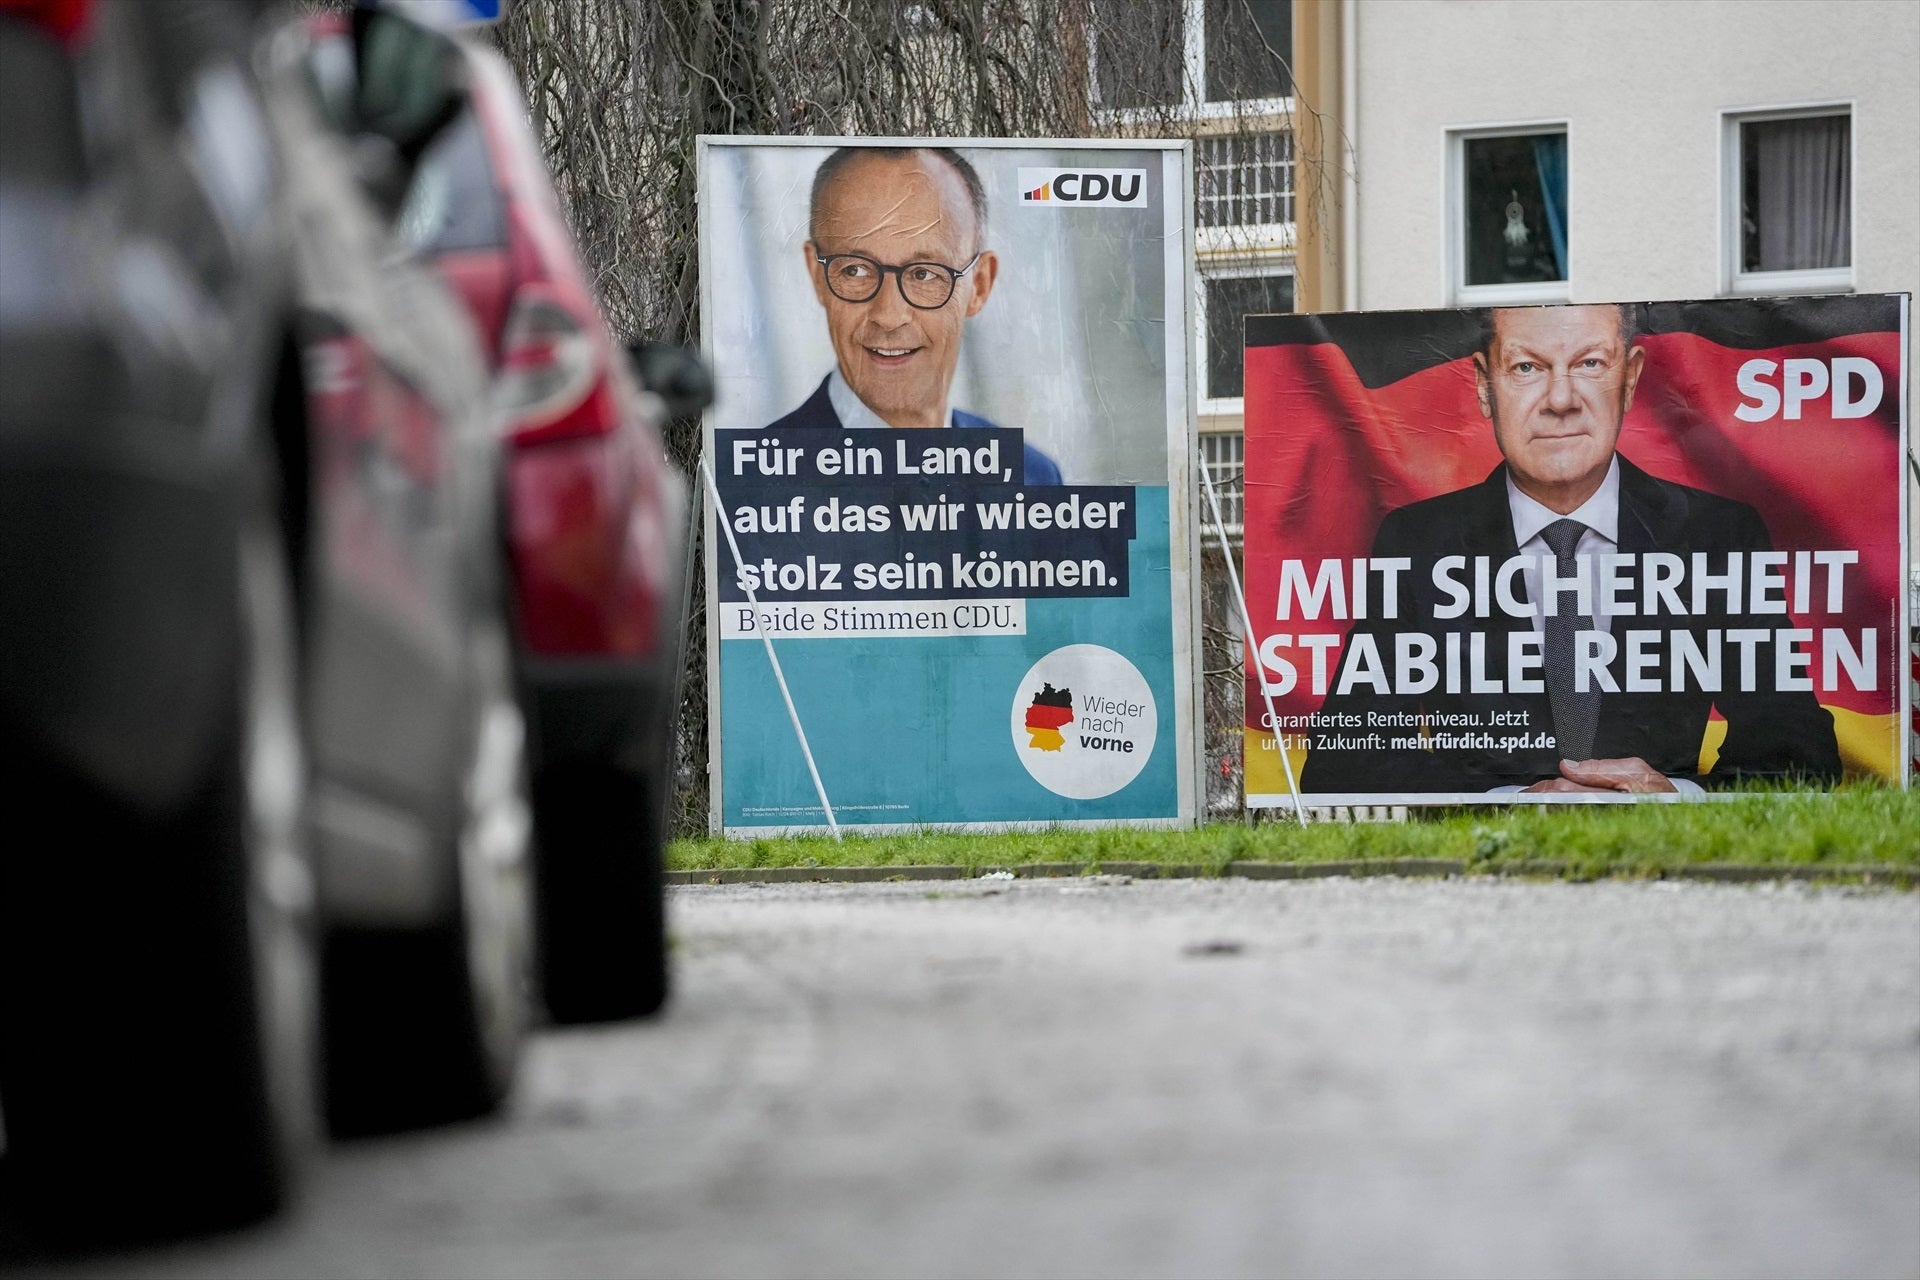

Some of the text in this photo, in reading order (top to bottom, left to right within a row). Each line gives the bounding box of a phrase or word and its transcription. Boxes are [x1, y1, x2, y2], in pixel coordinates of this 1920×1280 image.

[1052, 173, 1142, 202] CDU
[1733, 357, 1884, 423] SPD
[733, 437, 1012, 482] Für ein Land,
[734, 492, 1126, 534] auf das wir wieder
[736, 550, 1119, 592] stolz sein können.
[1275, 550, 1859, 622] MIT SICHERHEIT
[738, 605, 1018, 632] Beide Stimmen CDU.
[1259, 627, 1878, 697] STABILE RENTEN
[1083, 695, 1146, 718] Wieder
[1261, 710, 1530, 728] Garantiertes Rentenniveau. Jetzt
[1081, 716, 1124, 734] nach
[1080, 735, 1134, 753] vorne
[1262, 732, 1556, 753] und in Zukunft: mehrfürdich.spd.de
